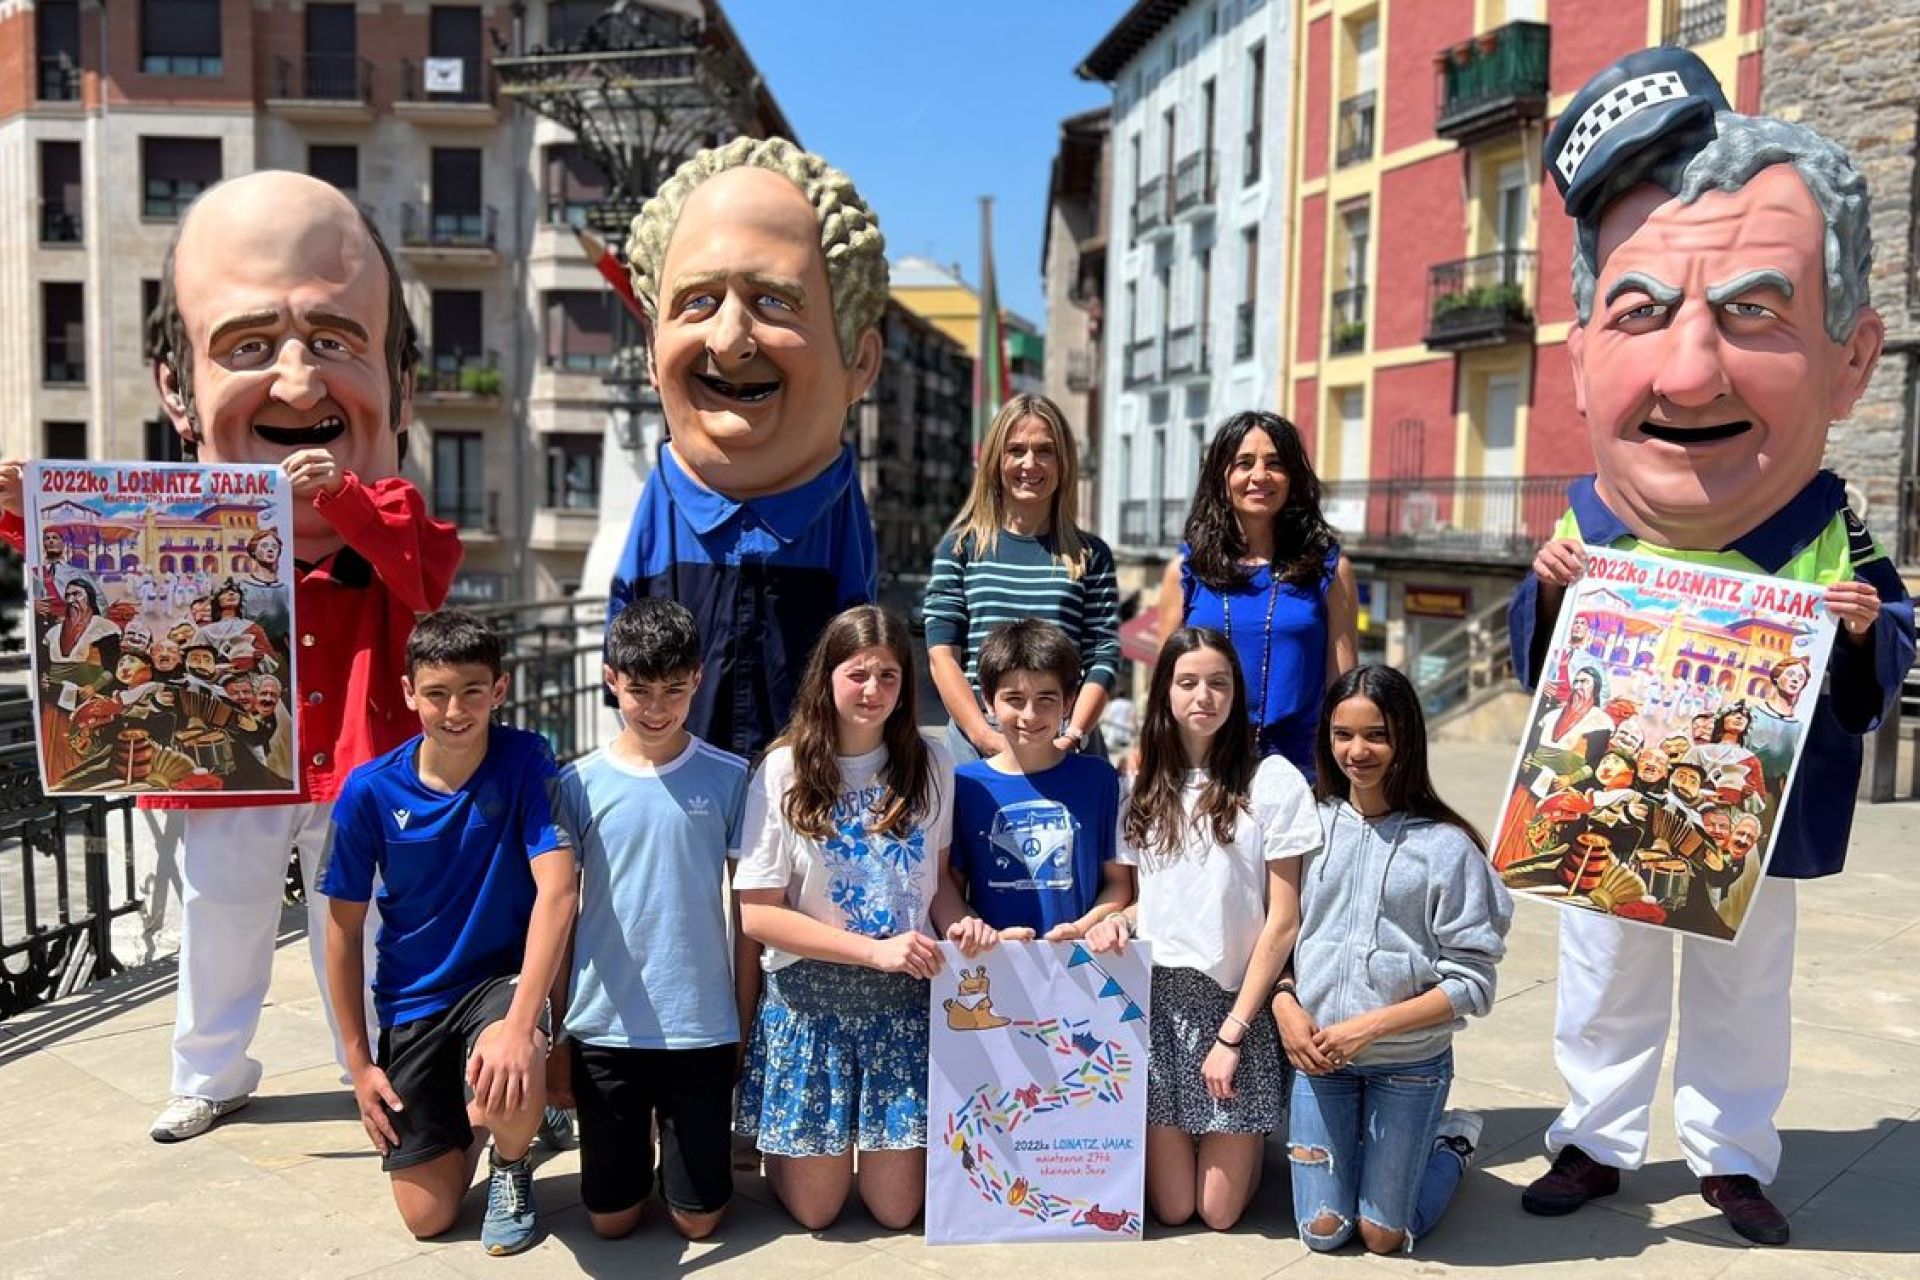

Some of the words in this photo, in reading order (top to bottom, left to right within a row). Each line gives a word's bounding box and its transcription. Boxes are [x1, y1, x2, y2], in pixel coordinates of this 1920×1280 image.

[42, 470, 108, 492] 2022ko
[117, 470, 202, 494] LOINATZ
[1588, 556, 1648, 584] 2022ko
[1655, 567, 1742, 602] LOINATZ
